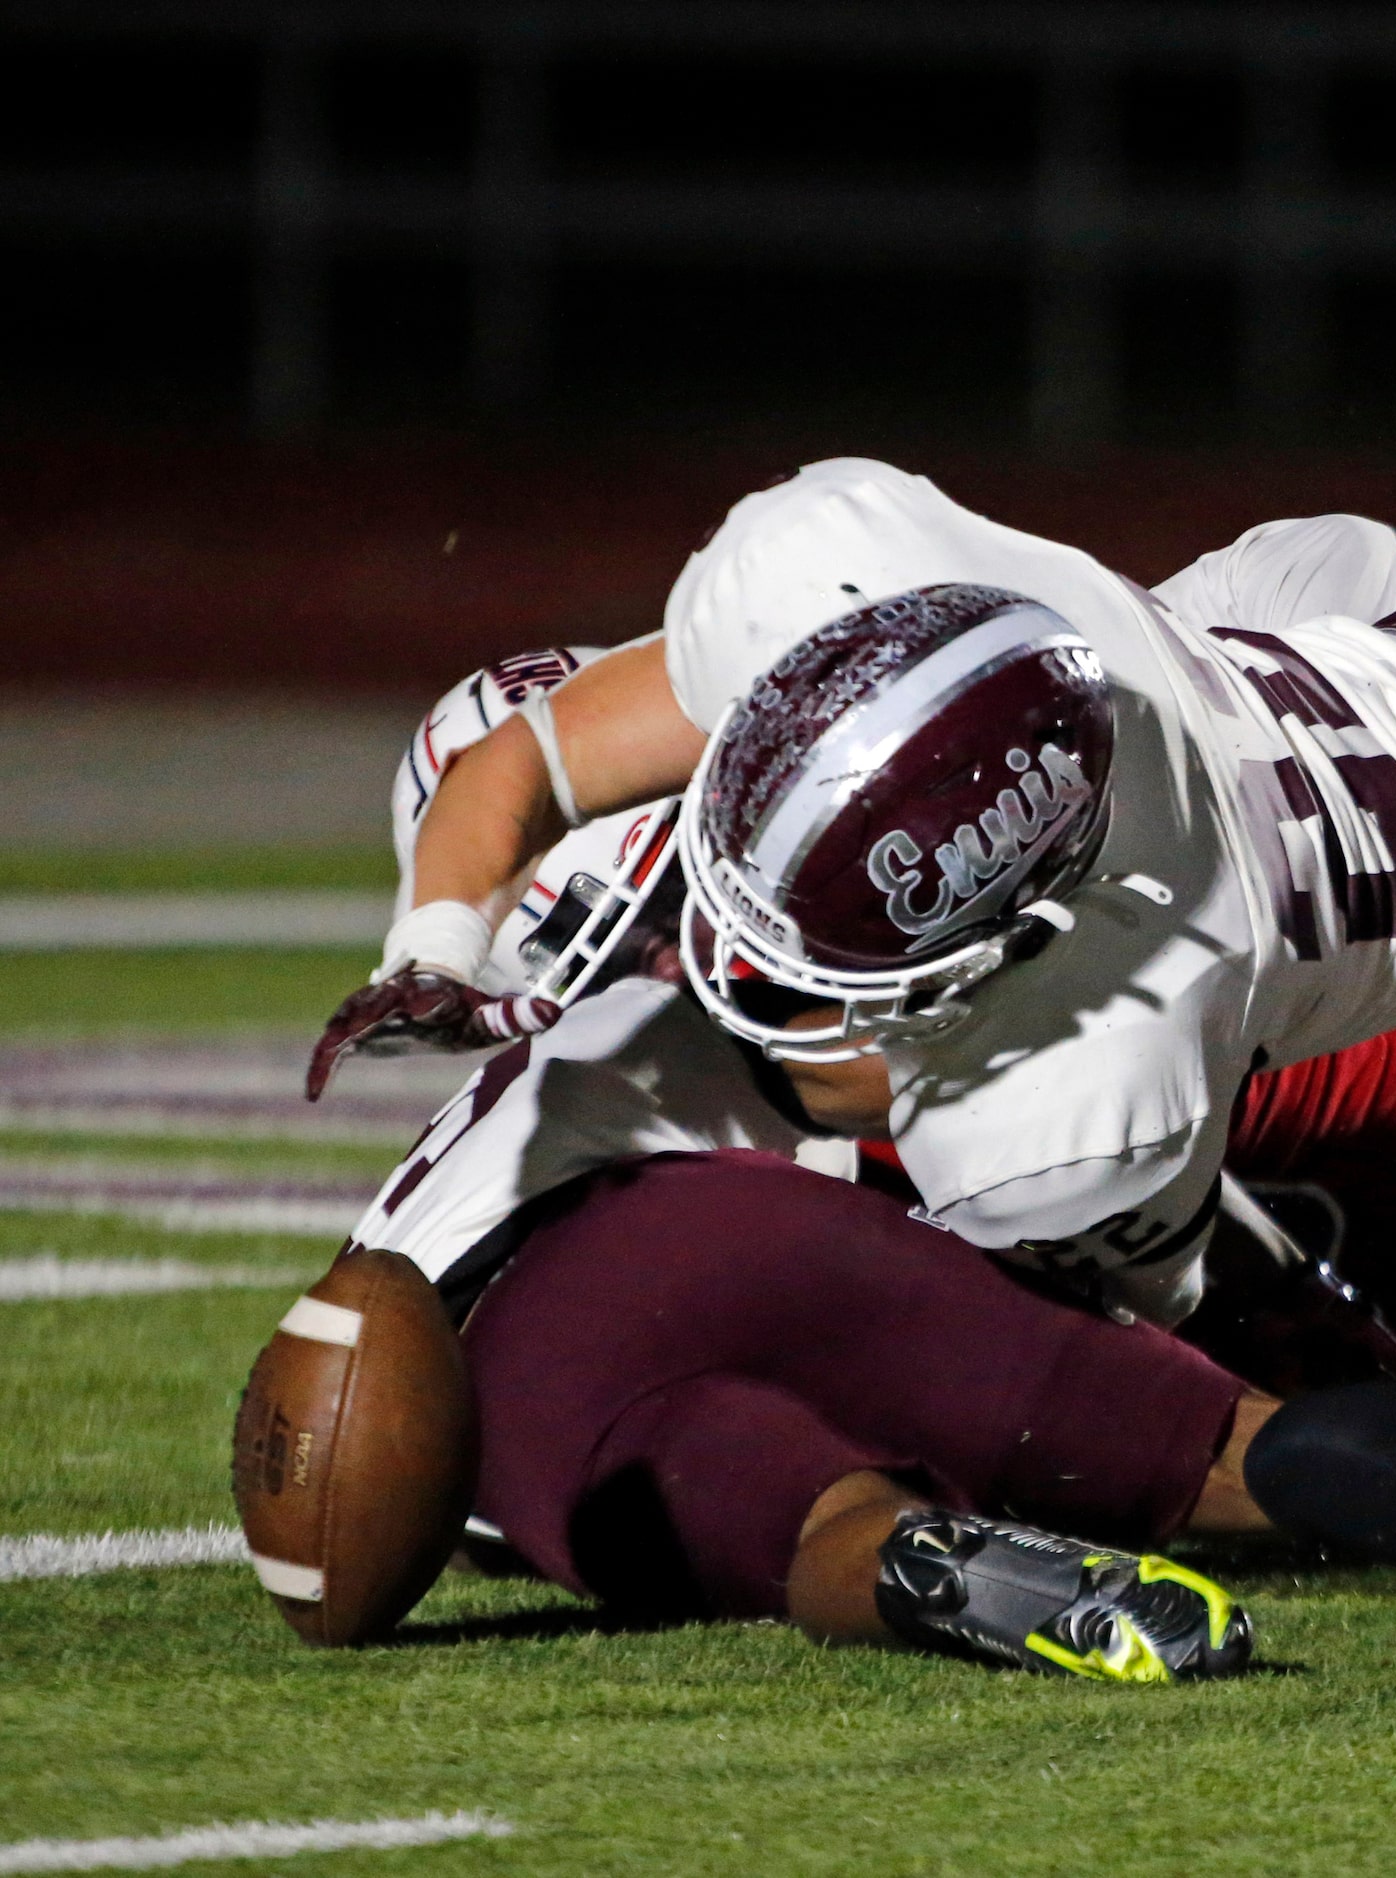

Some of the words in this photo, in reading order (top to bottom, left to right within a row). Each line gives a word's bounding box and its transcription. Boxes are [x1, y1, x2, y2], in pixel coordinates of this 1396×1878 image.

[867, 743, 1092, 935] Ennis
[719, 871, 787, 944] LIONS
[293, 1432, 314, 1486] NCAA
